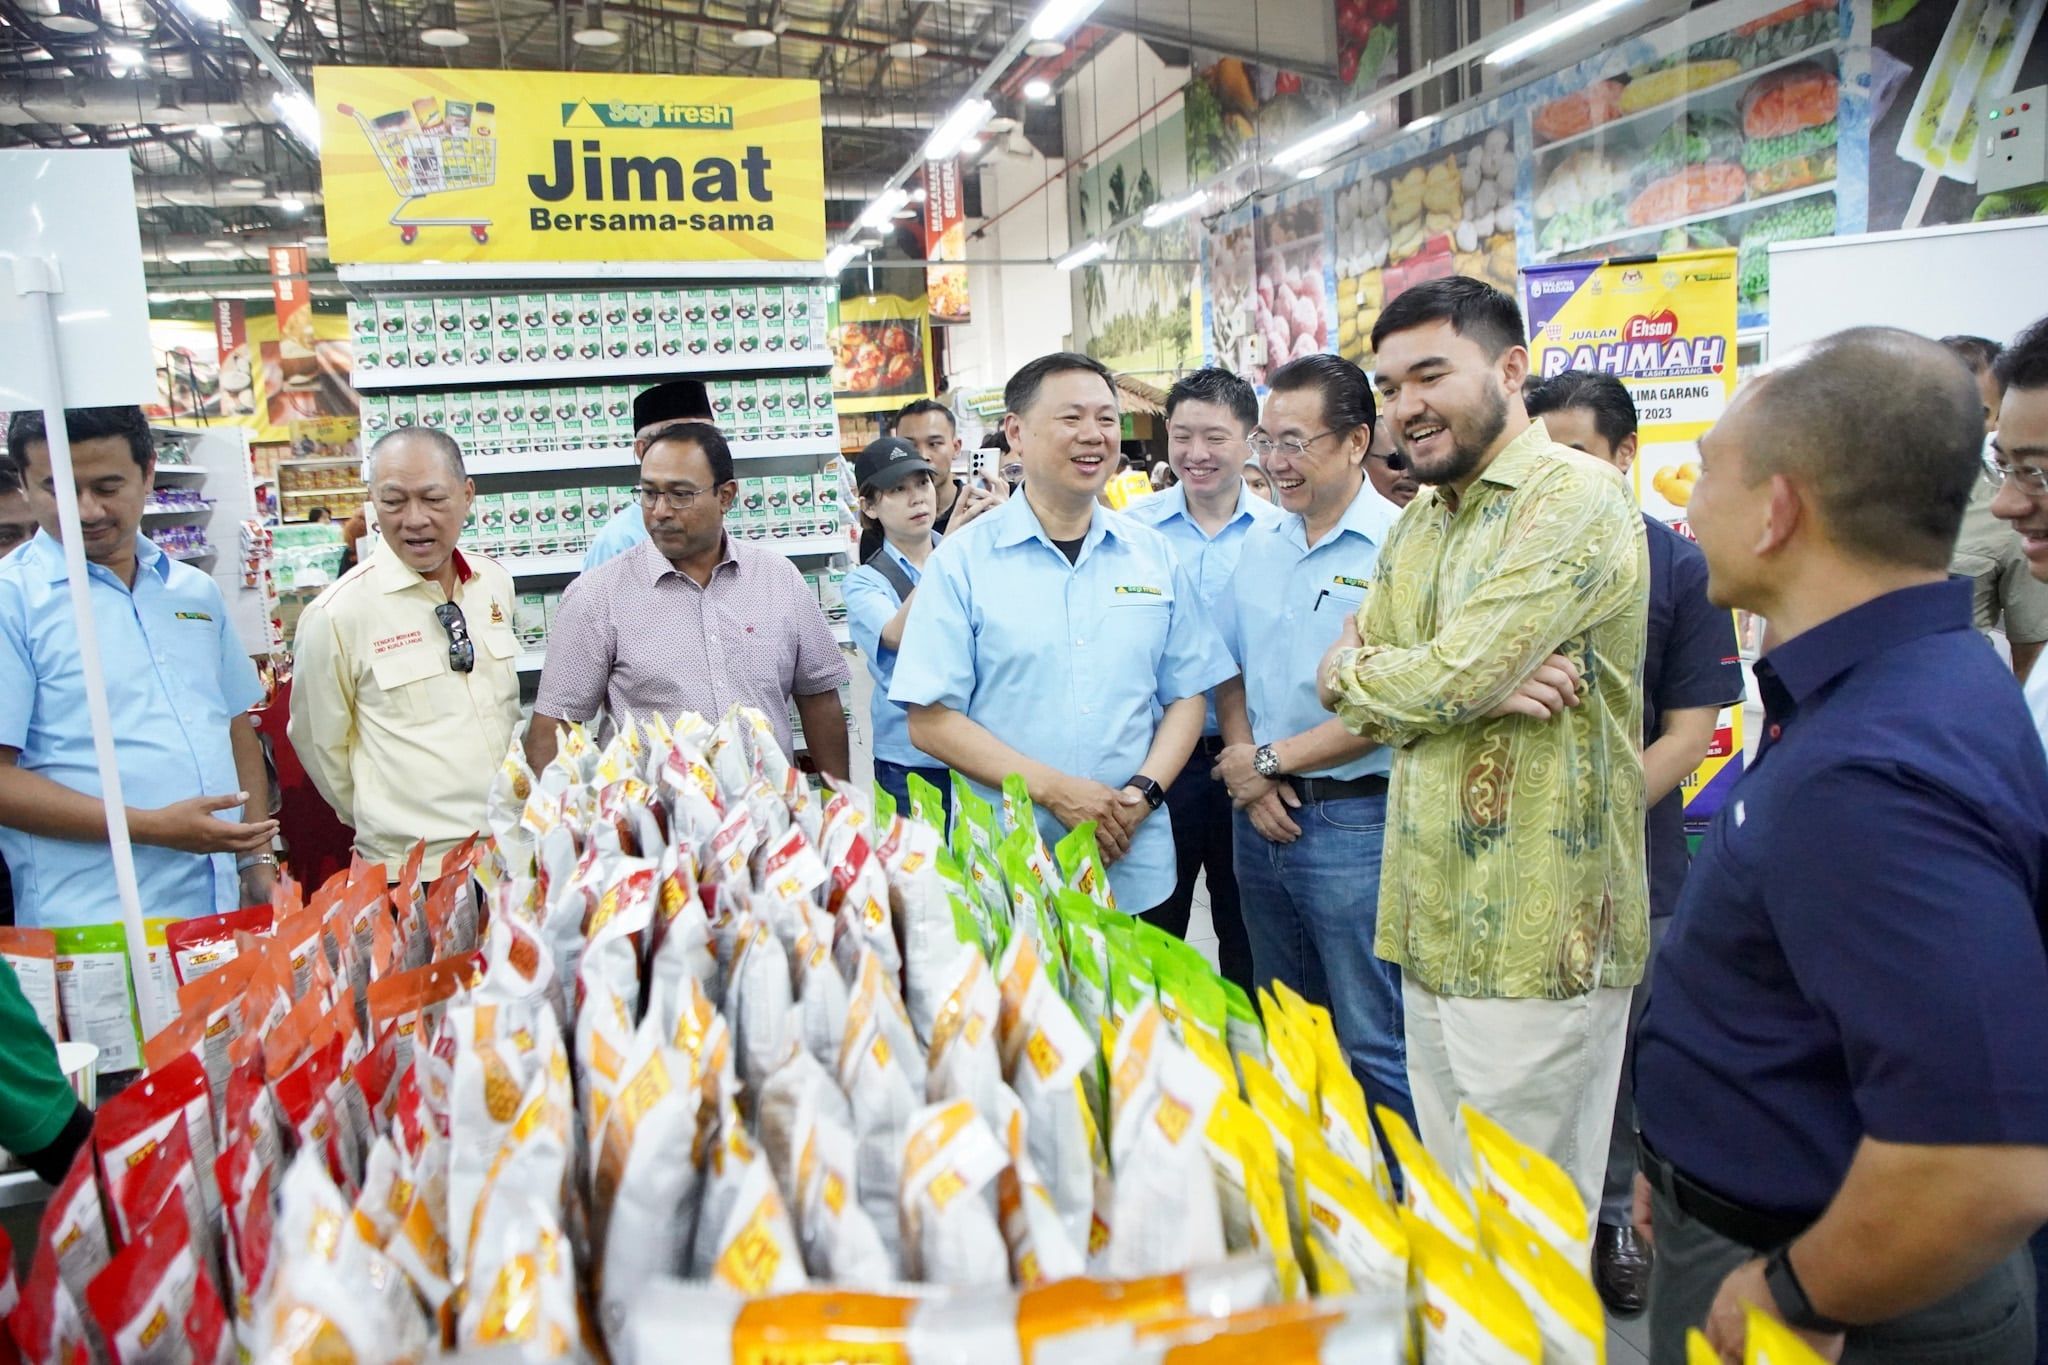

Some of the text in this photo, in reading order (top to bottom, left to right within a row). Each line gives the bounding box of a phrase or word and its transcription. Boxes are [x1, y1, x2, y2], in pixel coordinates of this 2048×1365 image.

[608, 99, 730, 127] Segi fresh
[527, 139, 773, 202] Jimat
[530, 208, 774, 231] Bersama-sama
[219, 301, 233, 351] TEPUNG
[1569, 328, 1617, 340] JUALAN
[1631, 319, 1672, 337] Ehsan
[1544, 337, 1723, 378] RAHMAH
[1668, 367, 1704, 377] SAYANG
[1660, 386, 1709, 400] GARANG
[1645, 407, 1672, 419] 2023
